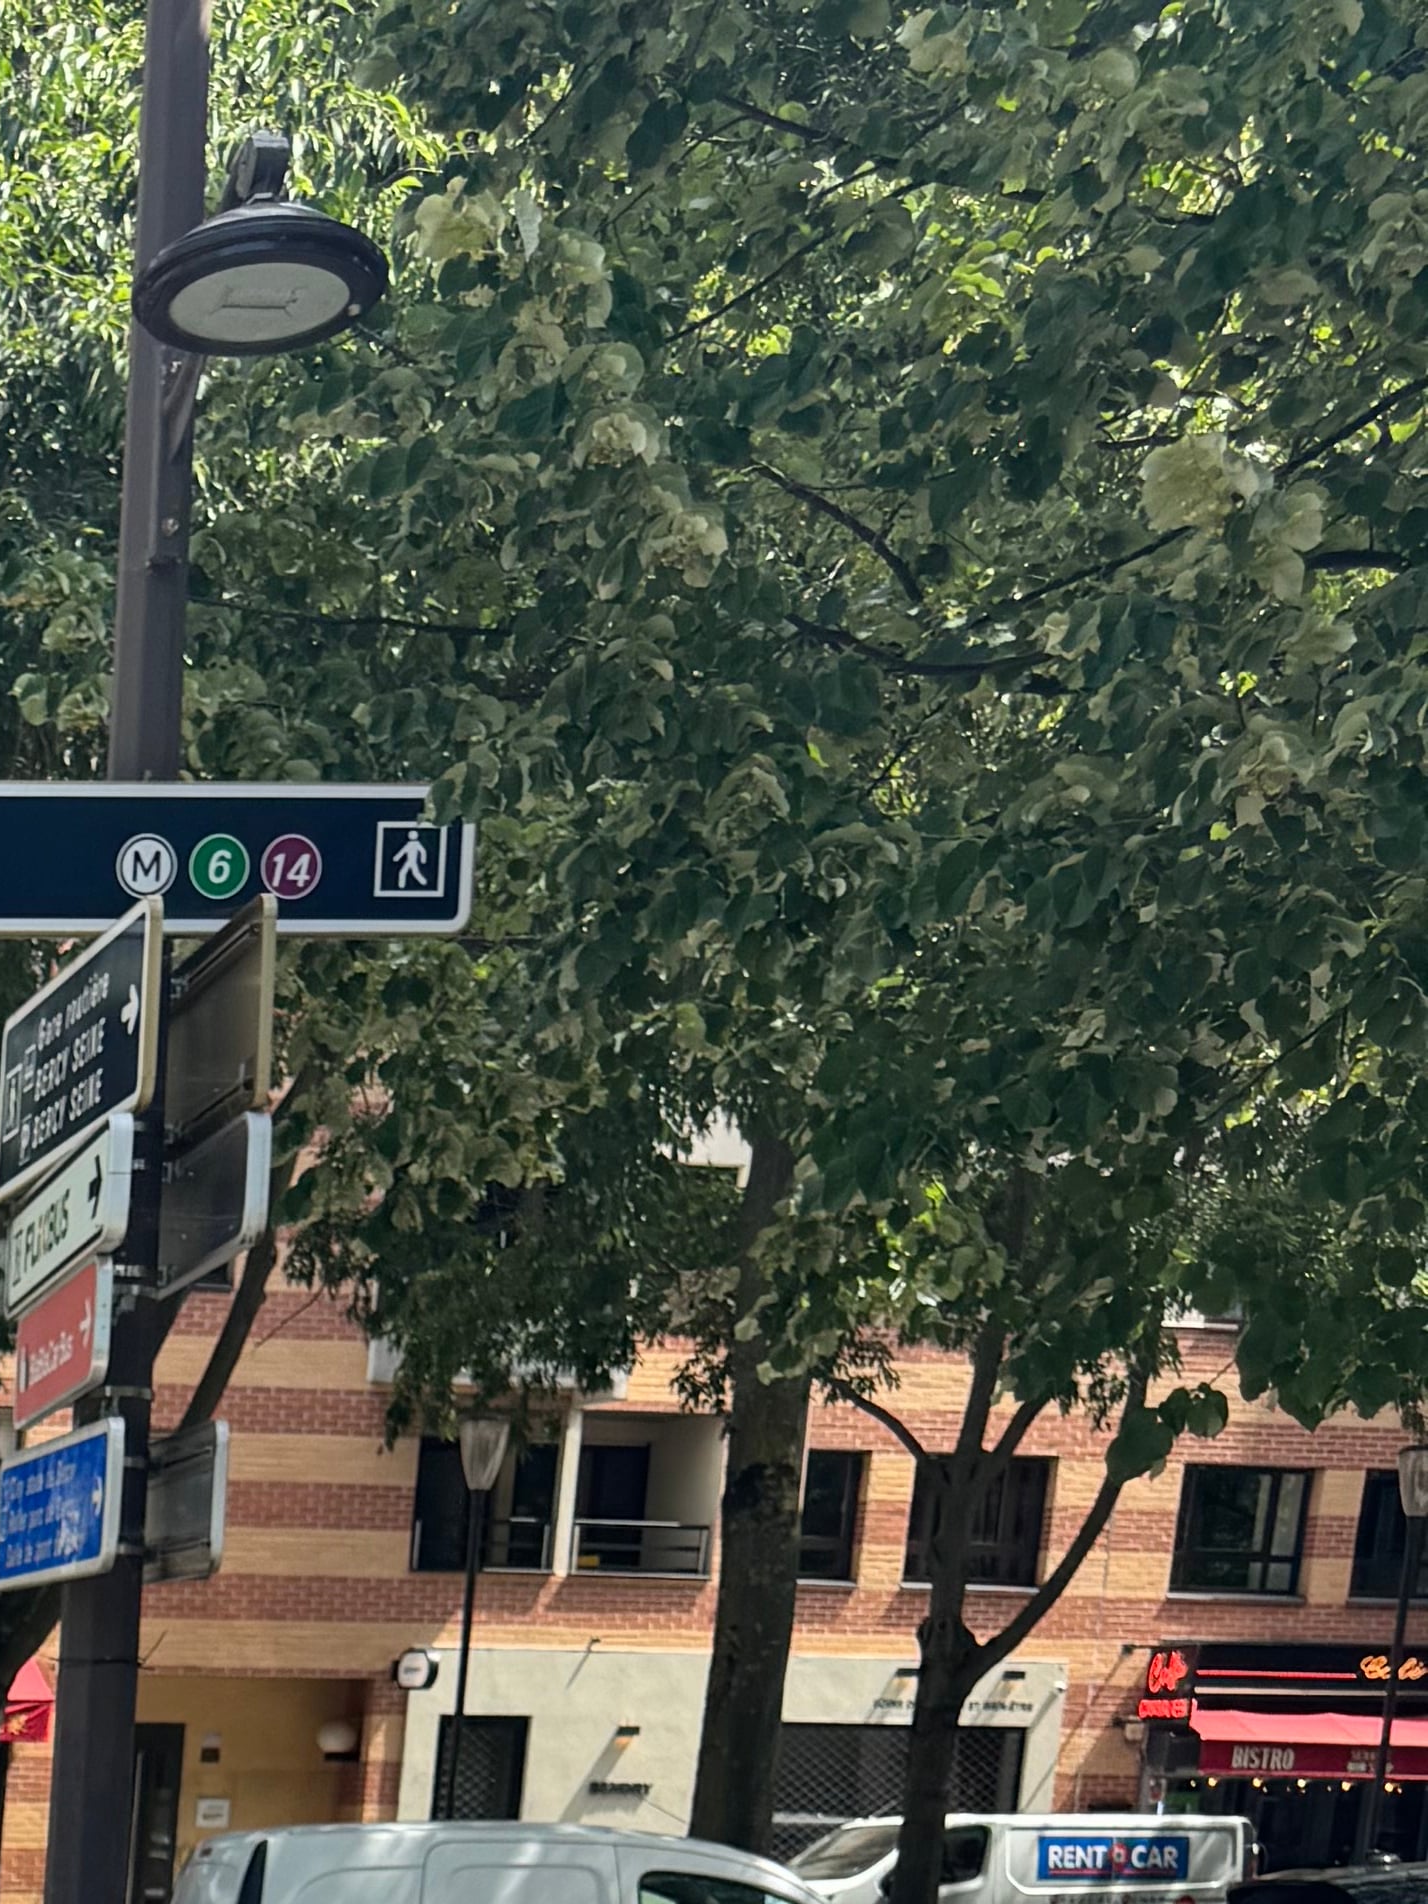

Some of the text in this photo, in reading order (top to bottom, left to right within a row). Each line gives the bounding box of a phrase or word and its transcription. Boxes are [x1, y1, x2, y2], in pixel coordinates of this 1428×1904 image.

[132, 849, 311, 887] M 6 14
[37, 1012, 64, 1051] Gare
[34, 1017, 106, 1102] BERCY SEINE
[31, 1095, 67, 1149] BERCY
[68, 1068, 104, 1121] SEINE
[1232, 1745, 1295, 1770] BISTRO
[1048, 1844, 1108, 1869] RENT
[1131, 1844, 1178, 1869] CAR
